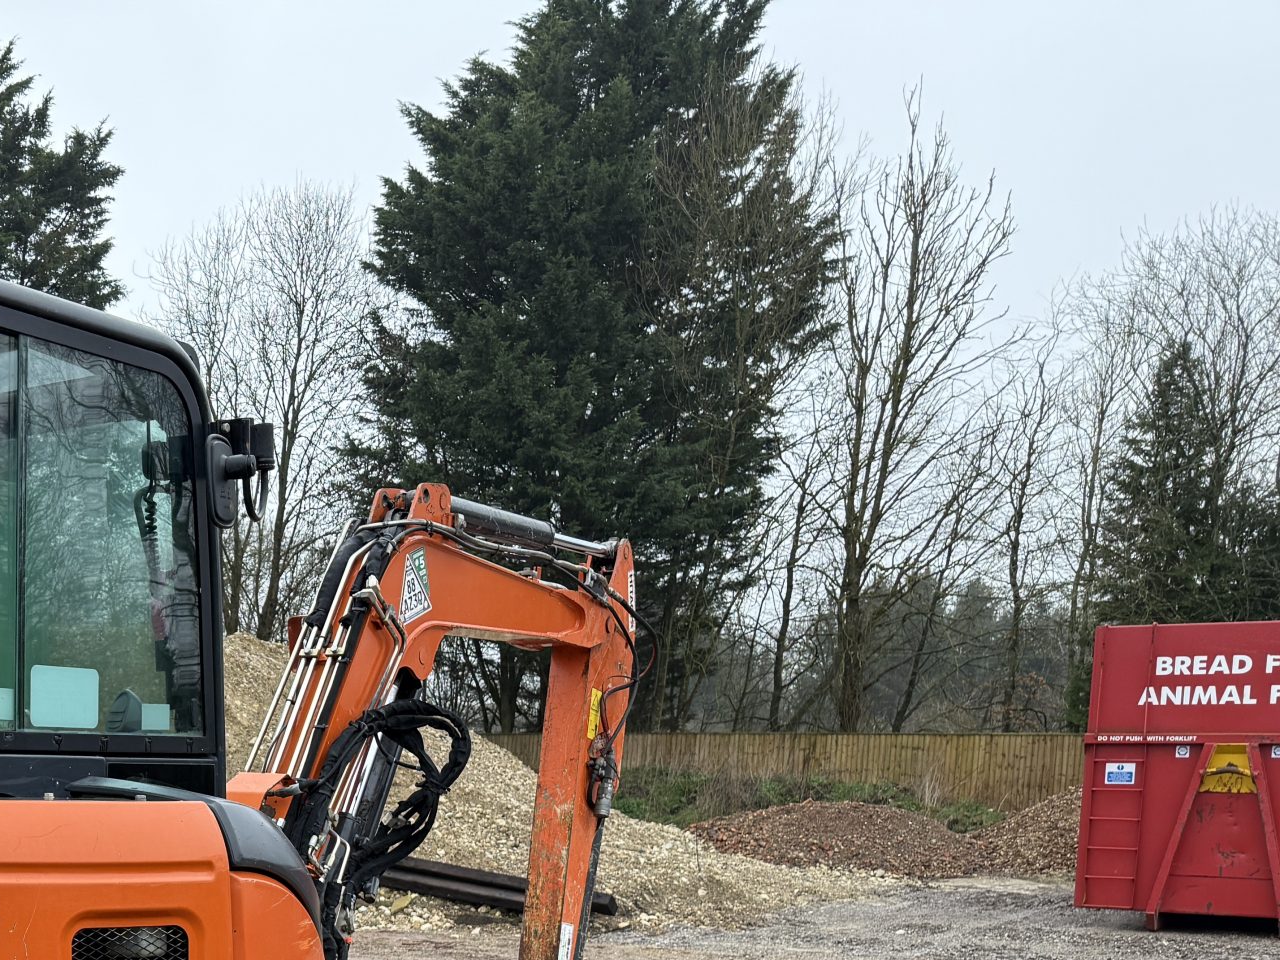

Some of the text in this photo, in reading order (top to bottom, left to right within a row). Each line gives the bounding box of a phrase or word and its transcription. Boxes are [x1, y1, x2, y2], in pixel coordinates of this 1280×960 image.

[406, 577, 416, 595] 88
[1155, 654, 1280, 676] BREAD F
[1137, 684, 1258, 706] ANIMAL
